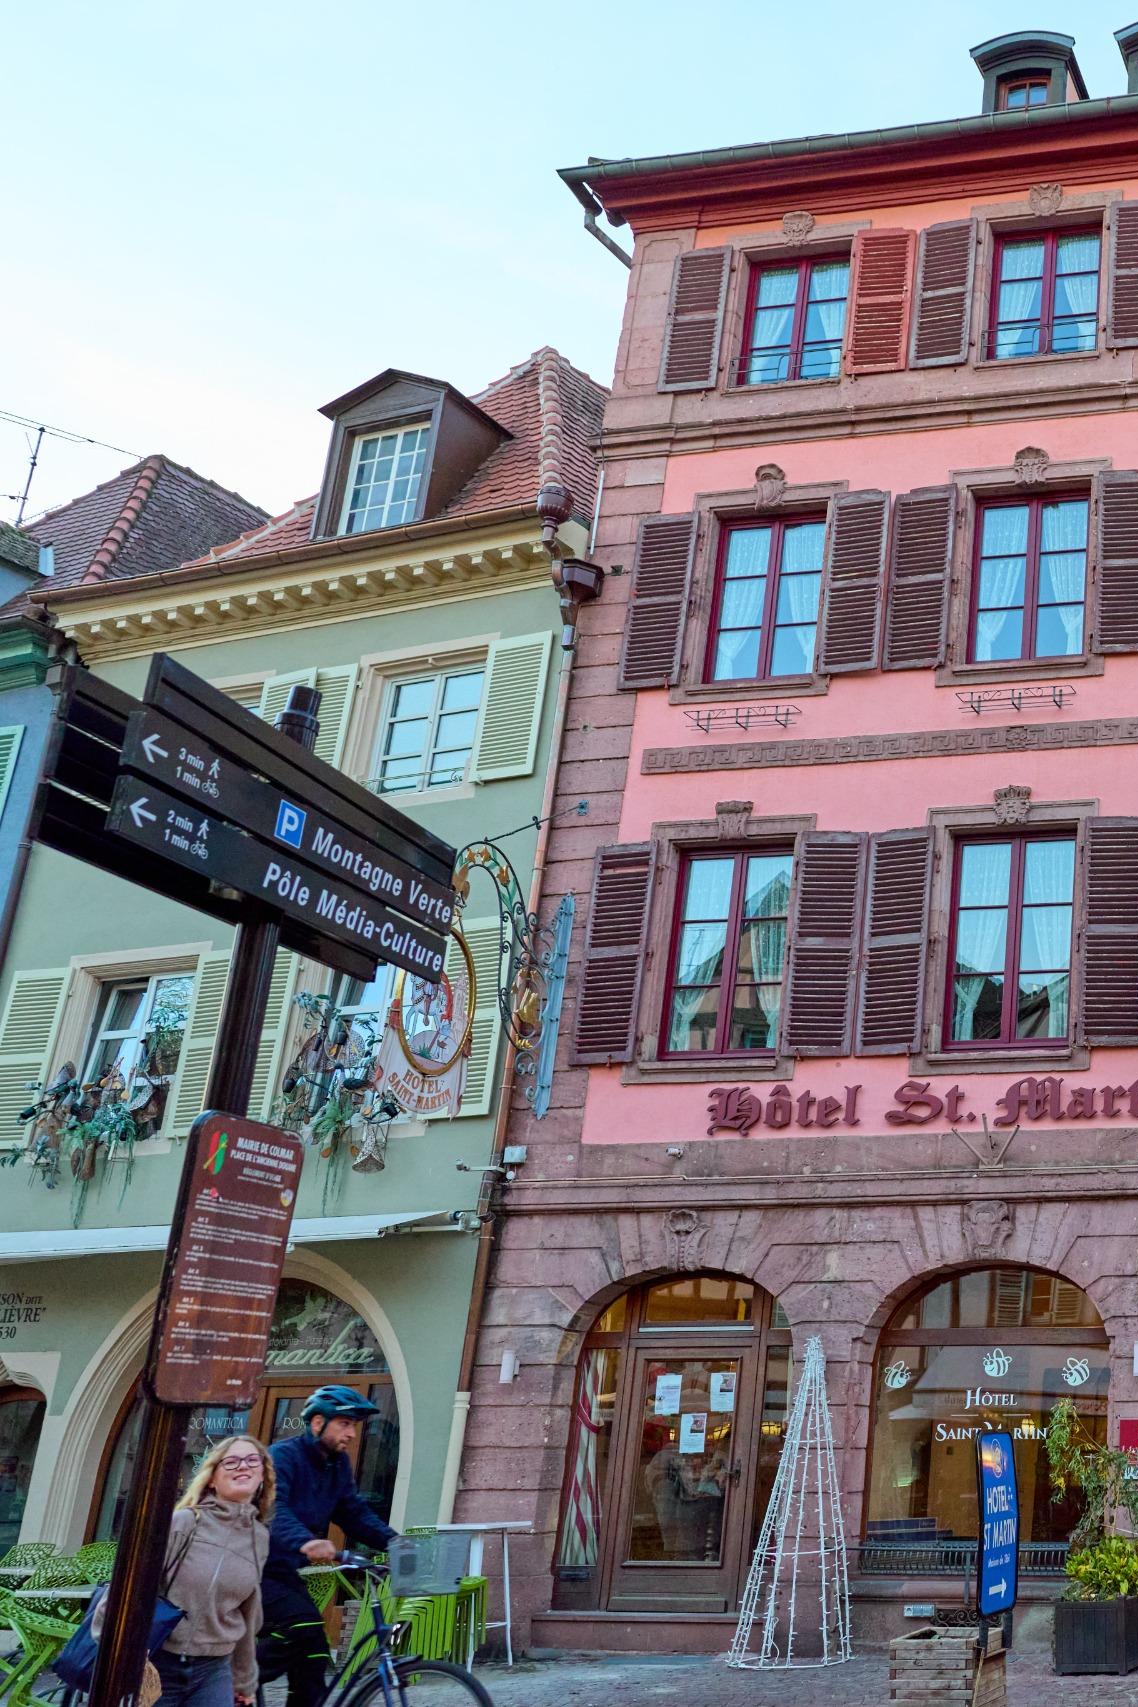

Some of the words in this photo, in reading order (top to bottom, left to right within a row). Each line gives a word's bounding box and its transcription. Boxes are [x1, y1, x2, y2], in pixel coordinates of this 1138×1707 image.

[178, 747, 187, 761] 3
[186, 753, 205, 771] min
[176, 766, 181, 778] 1
[182, 771, 201, 789] min
[166, 810, 175, 823] 2
[175, 816, 194, 833] min
[164, 828, 170, 841] 1
[171, 834, 189, 851] min
[280, 807, 300, 837] P
[311, 826, 403, 897] Montagne
[408, 879, 452, 924] Verte
[262, 862, 310, 907] Pôle
[315, 888, 443, 972] Média-Culture
[403, 1069, 441, 1094] HOTEL
[706, 1083, 864, 1137] Hôtel
[883, 1078, 978, 1127] St.
[230, 1149, 246, 1161] PLACE
[245, 1152, 252, 1162] DE
[236, 1137, 260, 1153] MAIRIE
[259, 1142, 268, 1155] DE
[269, 1145, 295, 1161] COLMAR
[0, 1292, 24, 1305] SON
[986, 1487, 1009, 1515] HOTEL
[983, 1524, 991, 1551] ST
[992, 1517, 1017, 1549] MARTIN
